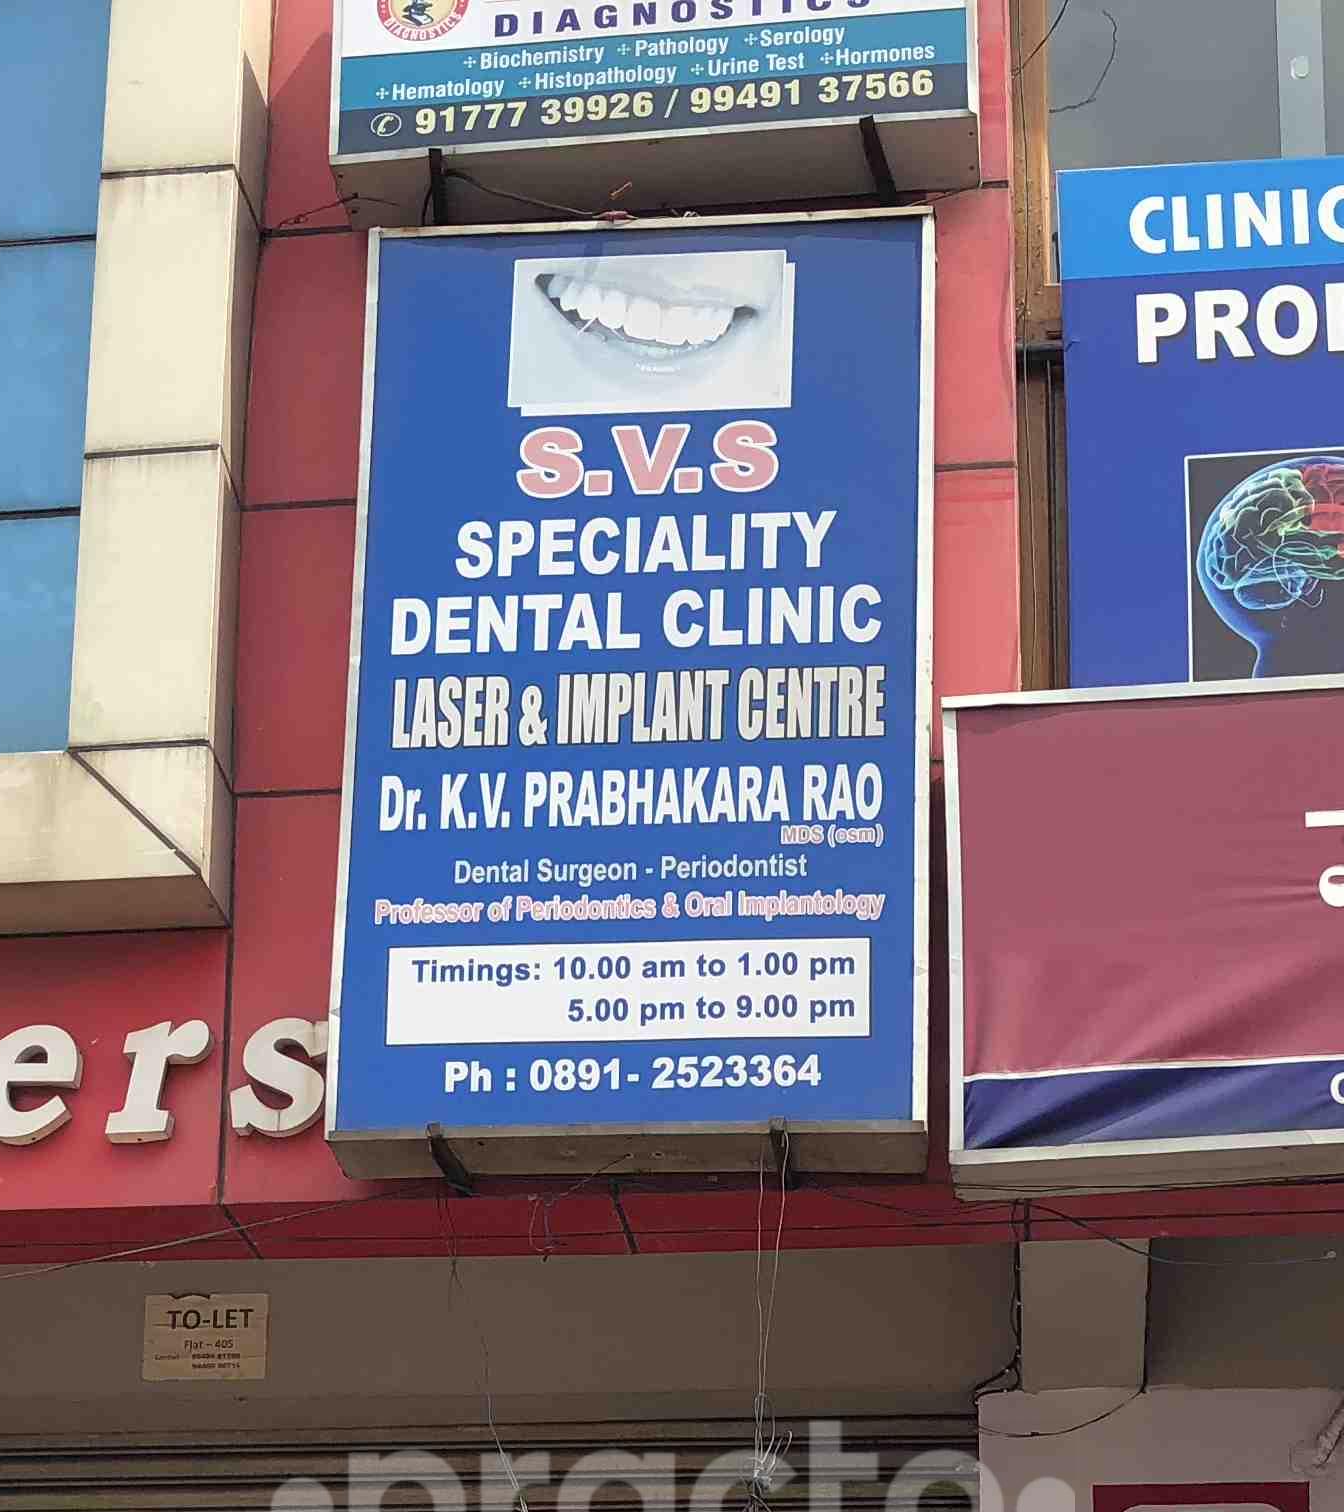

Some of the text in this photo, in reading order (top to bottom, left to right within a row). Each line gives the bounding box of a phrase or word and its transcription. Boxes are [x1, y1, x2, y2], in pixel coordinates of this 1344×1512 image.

[392, 44, 935, 101] Hematology Histopathology Urine Test Hormones
[480, 26, 845, 71] Biochemistry Pathology Serology
[415, 69, 934, 135] 91777 39926 99491 37566
[517, 420, 778, 500] S.V.S
[455, 510, 837, 579] SPECIALITY
[390, 584, 883, 656] DENTAL CLINIC
[391, 665, 886, 750] LASER & IMPLANT CENTRE
[378, 762, 884, 832] Dr. K.V. PRABHAKARA RAO
[454, 853, 807, 887] Dental Surgeon Periodontist
[374, 889, 885, 926] Professor of Periodontics & Oral Implantology
[411, 952, 856, 988] Timings: 10.00 am to 1.00 pm
[444, 1055, 822, 1094] Ph 0891- 2523364
[166, 1308, 254, 1329] TO-LET
